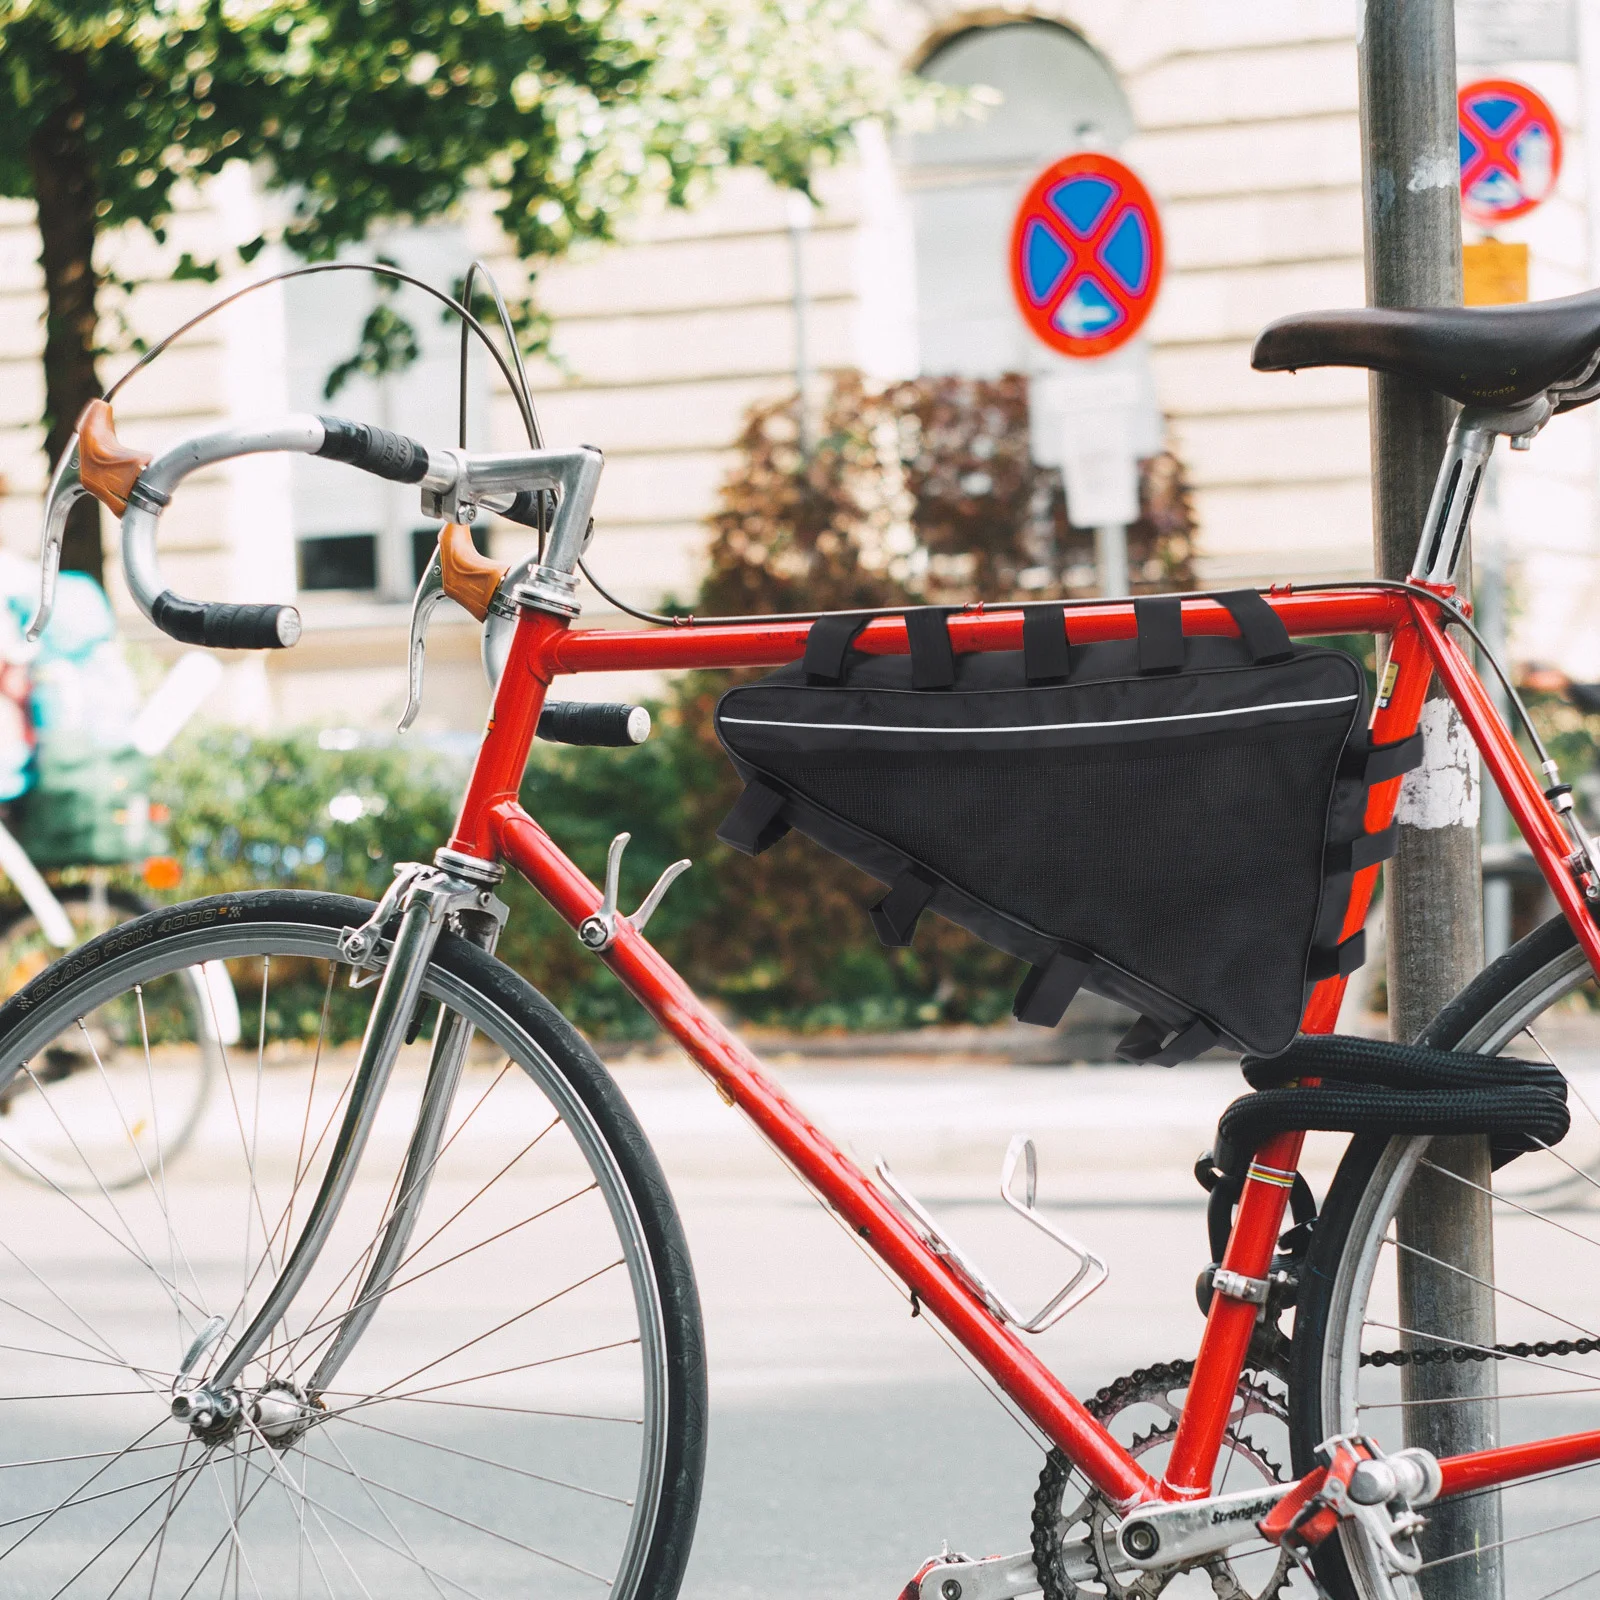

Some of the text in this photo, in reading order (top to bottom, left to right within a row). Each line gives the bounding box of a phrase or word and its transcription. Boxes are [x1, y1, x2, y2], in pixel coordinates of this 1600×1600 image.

[32, 948, 100, 1001] GRAND
[103, 924, 154, 957] PRIX
[1211, 1498, 1279, 1525] Strongligh
